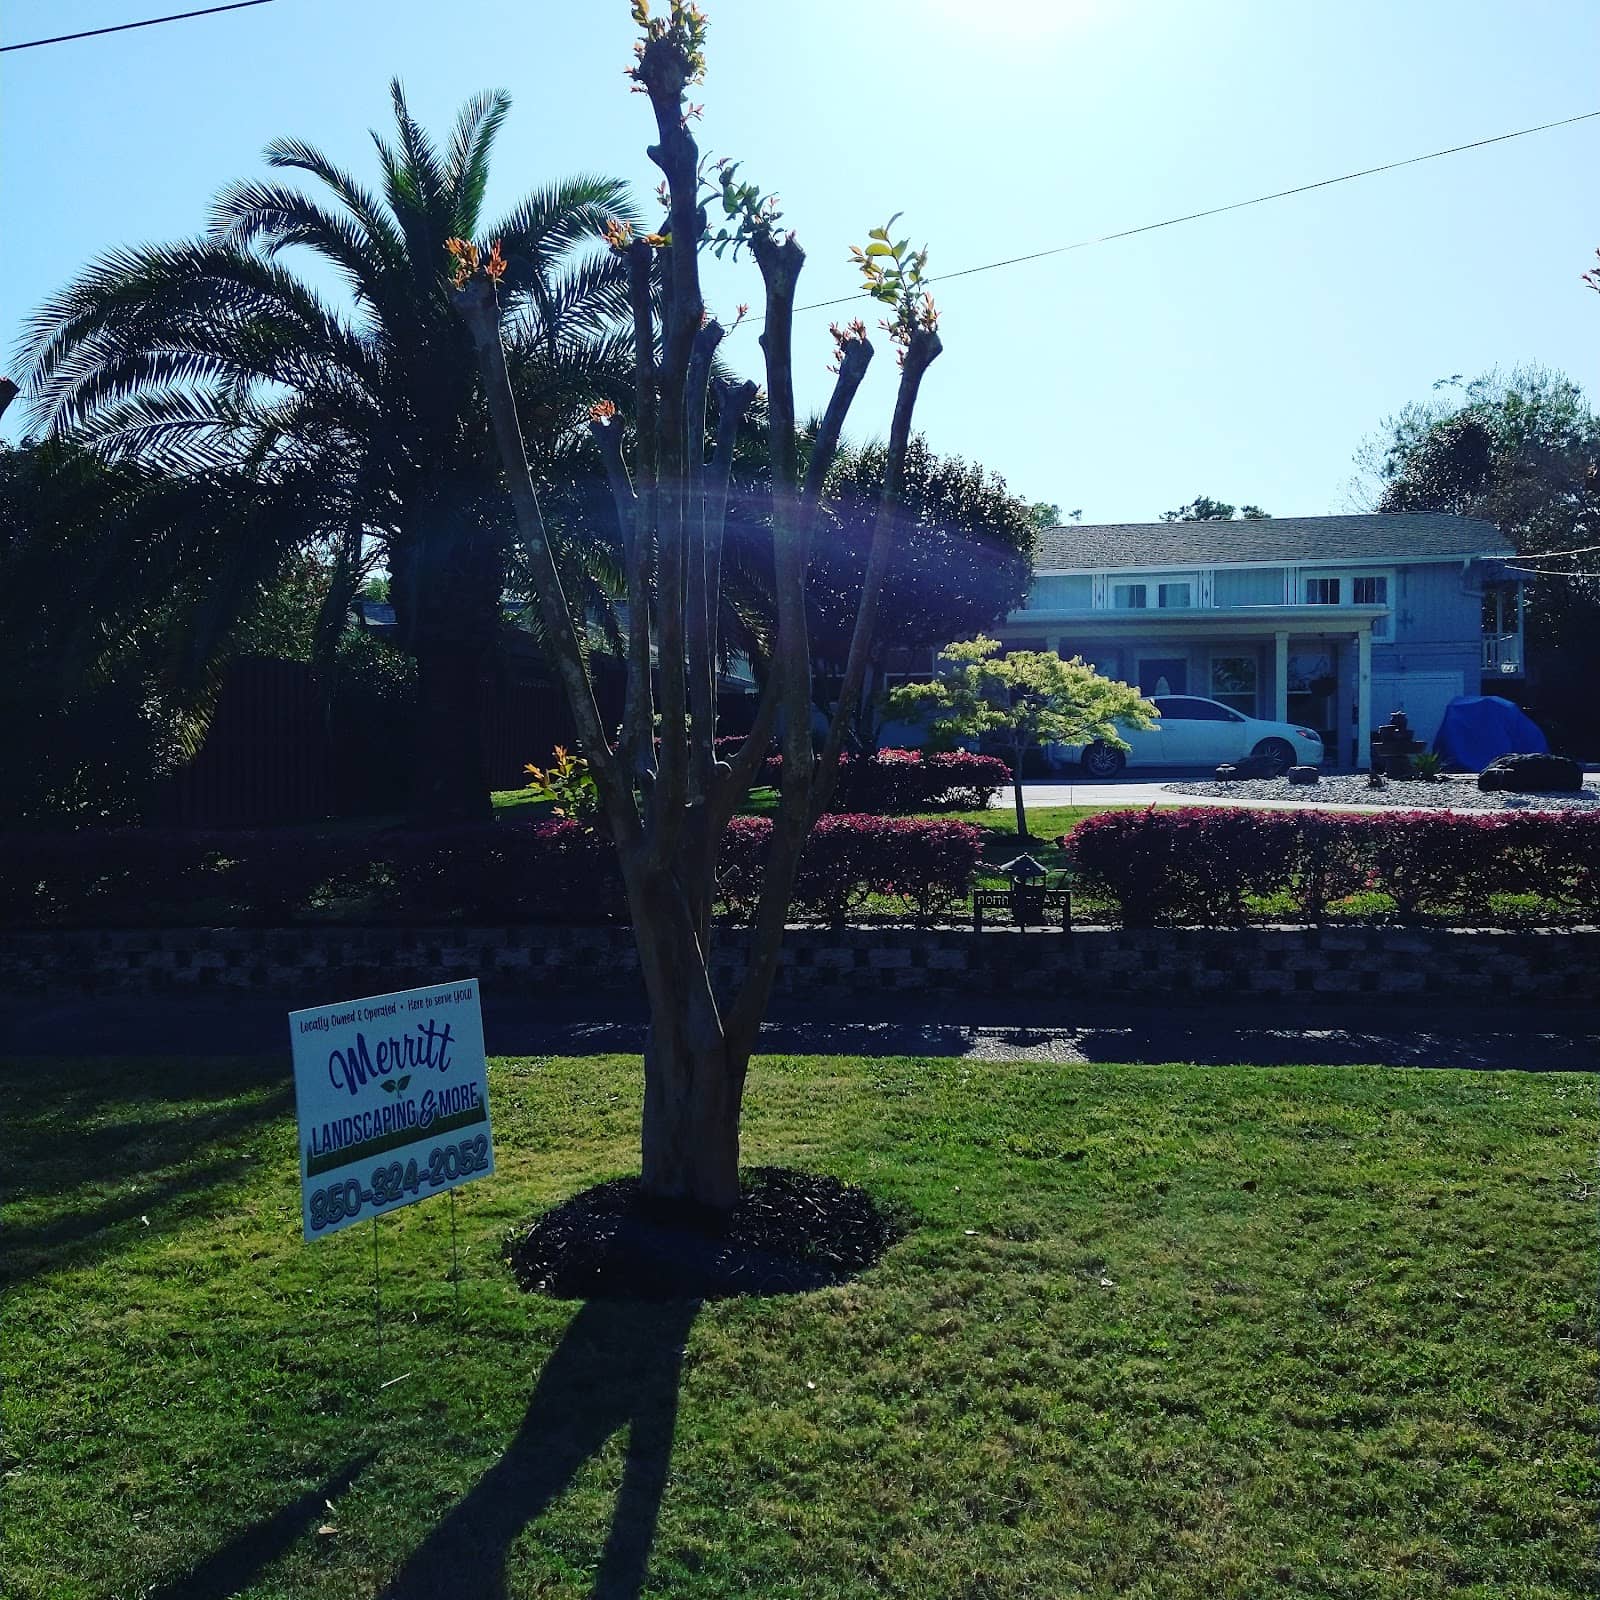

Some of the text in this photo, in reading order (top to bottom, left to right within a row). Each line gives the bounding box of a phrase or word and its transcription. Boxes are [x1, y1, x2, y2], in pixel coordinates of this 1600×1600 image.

[300, 1014, 329, 1034] Locally
[331, 1010, 356, 1027] Owned
[357, 1009, 364, 1022] &
[364, 1002, 397, 1023] Operated
[408, 999, 425, 1012] Here
[425, 996, 433, 1009] to
[434, 992, 452, 1006] serve
[329, 1018, 456, 1096] Merritt
[311, 1081, 480, 1157] LANDSCAPING & MORE
[310, 1133, 489, 1231] 850-324-2052
